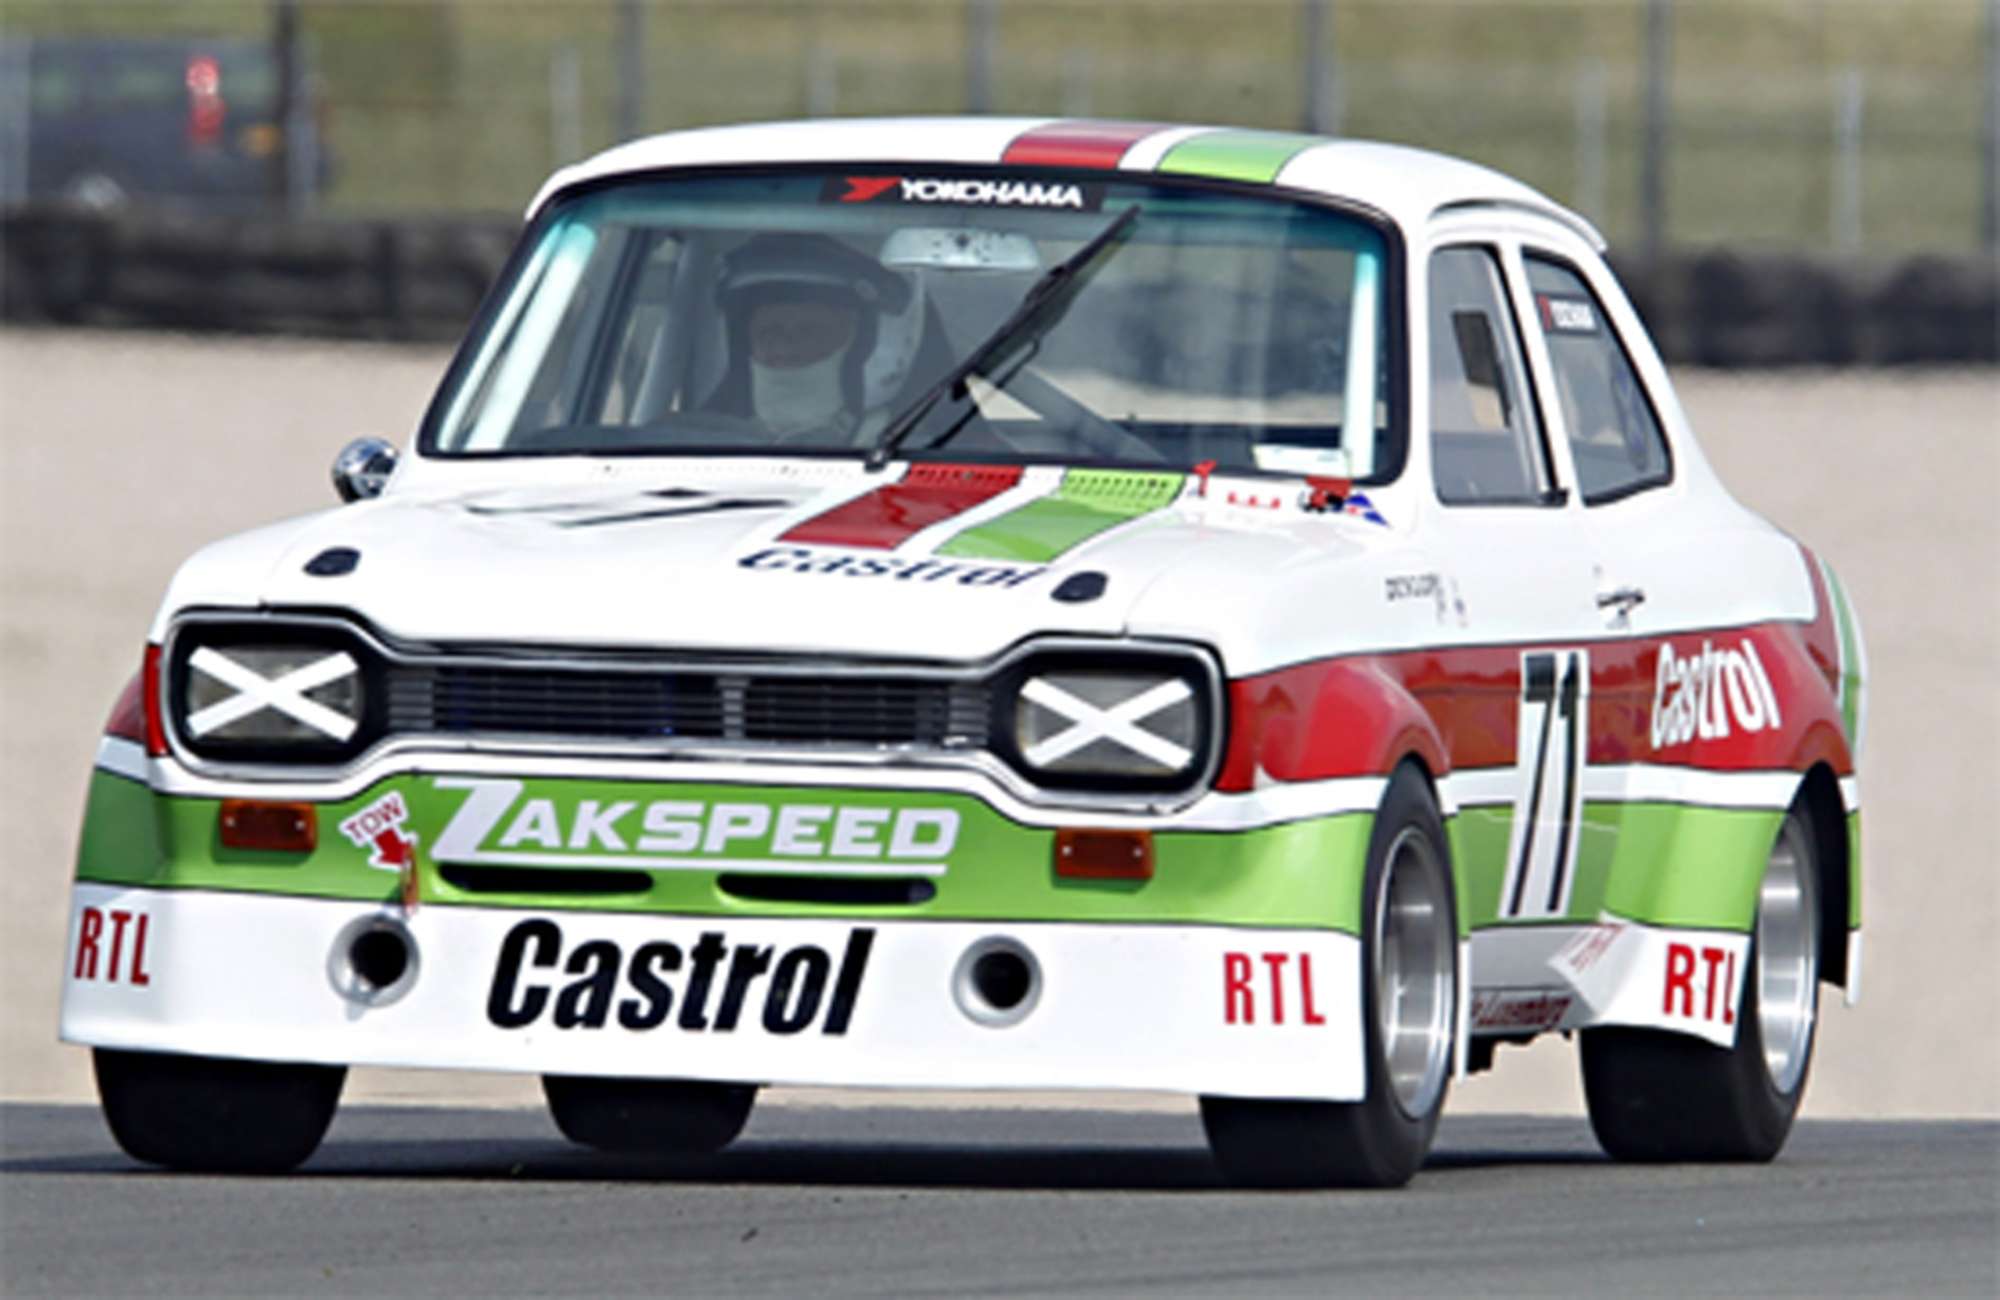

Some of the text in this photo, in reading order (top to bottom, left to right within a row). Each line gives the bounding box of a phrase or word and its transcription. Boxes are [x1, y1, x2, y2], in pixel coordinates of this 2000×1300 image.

[900, 180, 1083, 208] YOKOHAMA
[738, 548, 1046, 588] Castrol
[1652, 639, 1781, 750] Castrol
[345, 797, 402, 841] TOW
[430, 778, 960, 860] ZAKSPEED
[1507, 650, 1579, 916] 71
[73, 906, 150, 986] RTL
[486, 918, 877, 1036] Castrol
[1223, 952, 1327, 1026] RTL
